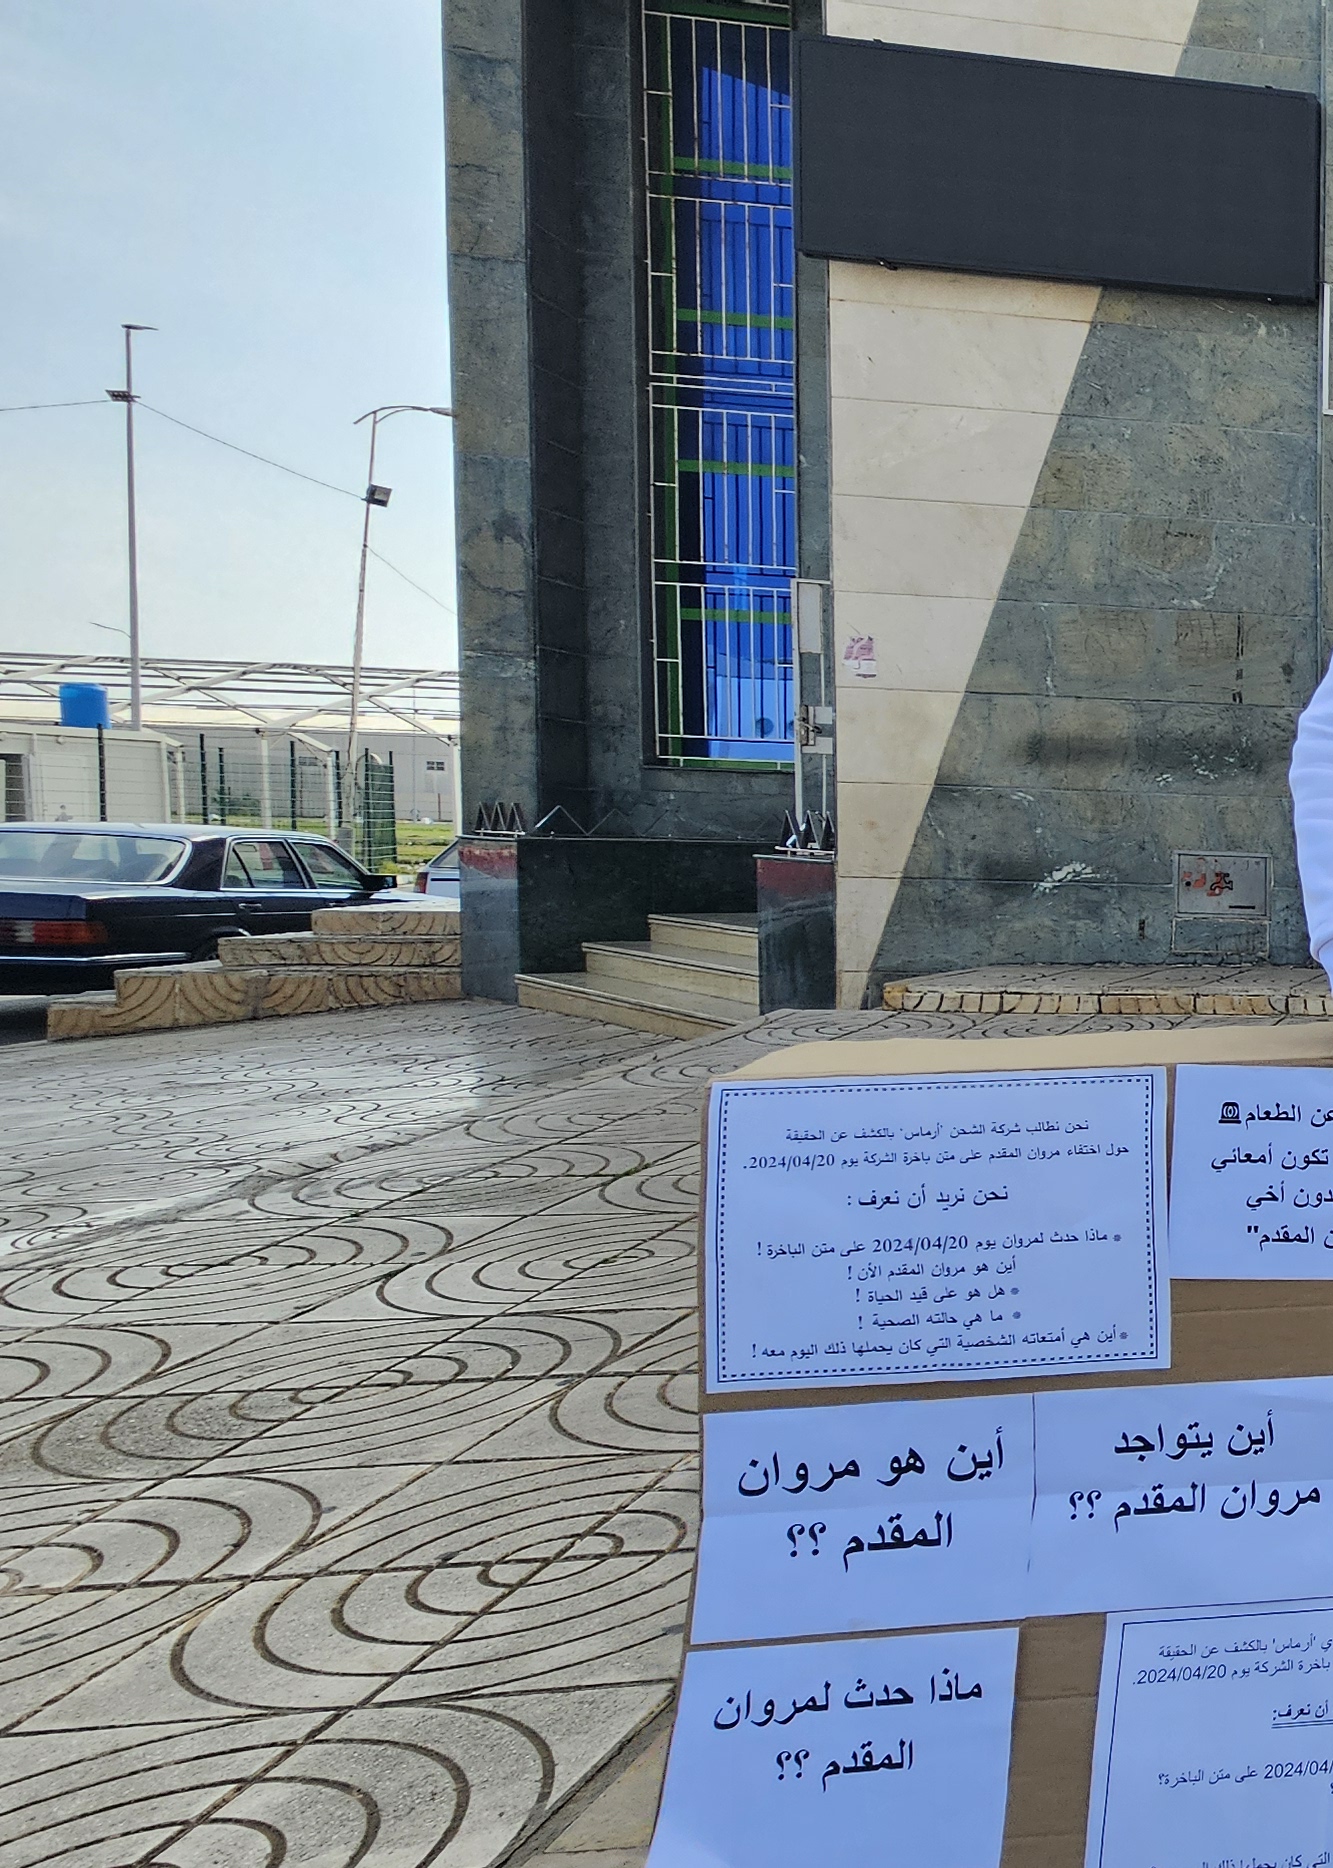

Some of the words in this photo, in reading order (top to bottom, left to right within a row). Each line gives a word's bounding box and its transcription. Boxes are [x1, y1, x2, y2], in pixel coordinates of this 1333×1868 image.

[1245, 1102, 1302, 1131] الطعام
[1280, 1148, 1329, 1171] تكون
[1245, 1179, 1285, 1212] أخي
[1246, 1224, 1315, 1252] المقدم"
[1113, 1421, 1214, 1463] يتواجد
[1227, 1408, 1275, 1457] أين
[737, 1450, 861, 1497] مروان
[876, 1446, 926, 1487] هو
[946, 1425, 1004, 1482] أين
[1113, 1480, 1206, 1534] المقدم
[1220, 1479, 1321, 1520] مروان
[842, 1509, 953, 1574] المقدم
[713, 1679, 832, 1731] لمروان
[843, 1677, 915, 1709] حدث
[930, 1667, 983, 1705] ماذا
[821, 1737, 914, 1794] المقدم
